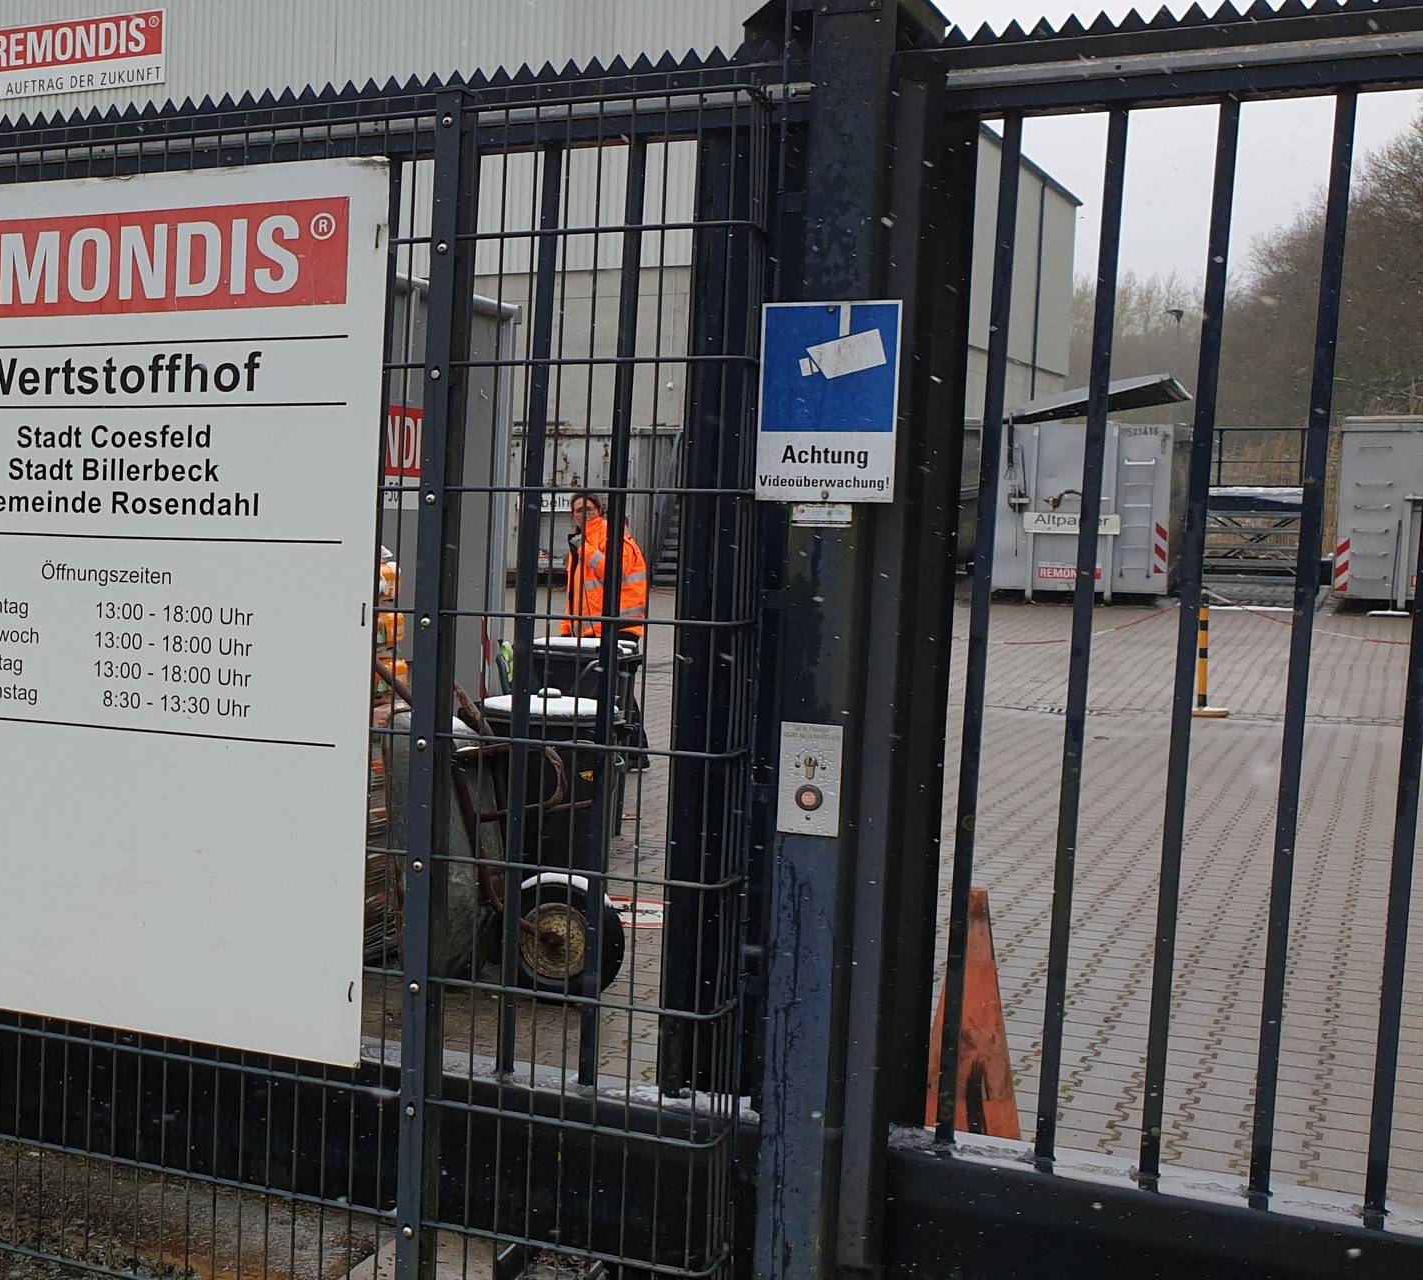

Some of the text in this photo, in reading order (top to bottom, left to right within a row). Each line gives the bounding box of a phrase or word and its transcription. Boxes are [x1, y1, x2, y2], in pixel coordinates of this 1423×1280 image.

[6, 77, 64, 95] AUFTRAG
[70, 73, 94, 89] DER
[100, 67, 162, 85] ZUKUNFT
[17, 424, 211, 448] Stadt Coesfeld
[8, 457, 219, 482] Stadt Billerbeck
[781, 445, 869, 469] Achtung
[759, 474, 890, 491] Videoüberwachung!
[112, 491, 259, 516] Rosendahl
[41, 560, 171, 586] Öffnungszeiten
[96, 602, 143, 620] 13:00
[163, 605, 212, 624] 18:00
[220, 607, 254, 626] Uhr
[95, 631, 142, 650] 13:00
[163, 635, 211, 654] 18:00
[219, 637, 253, 656] Uhr
[94, 660, 141, 680] 13:00
[162, 664, 210, 684] 18:00
[218, 668, 251, 687] Uhr
[103, 690, 140, 709] 8:30
[161, 694, 210, 714] 13:30
[217, 698, 251, 717] Uhr
